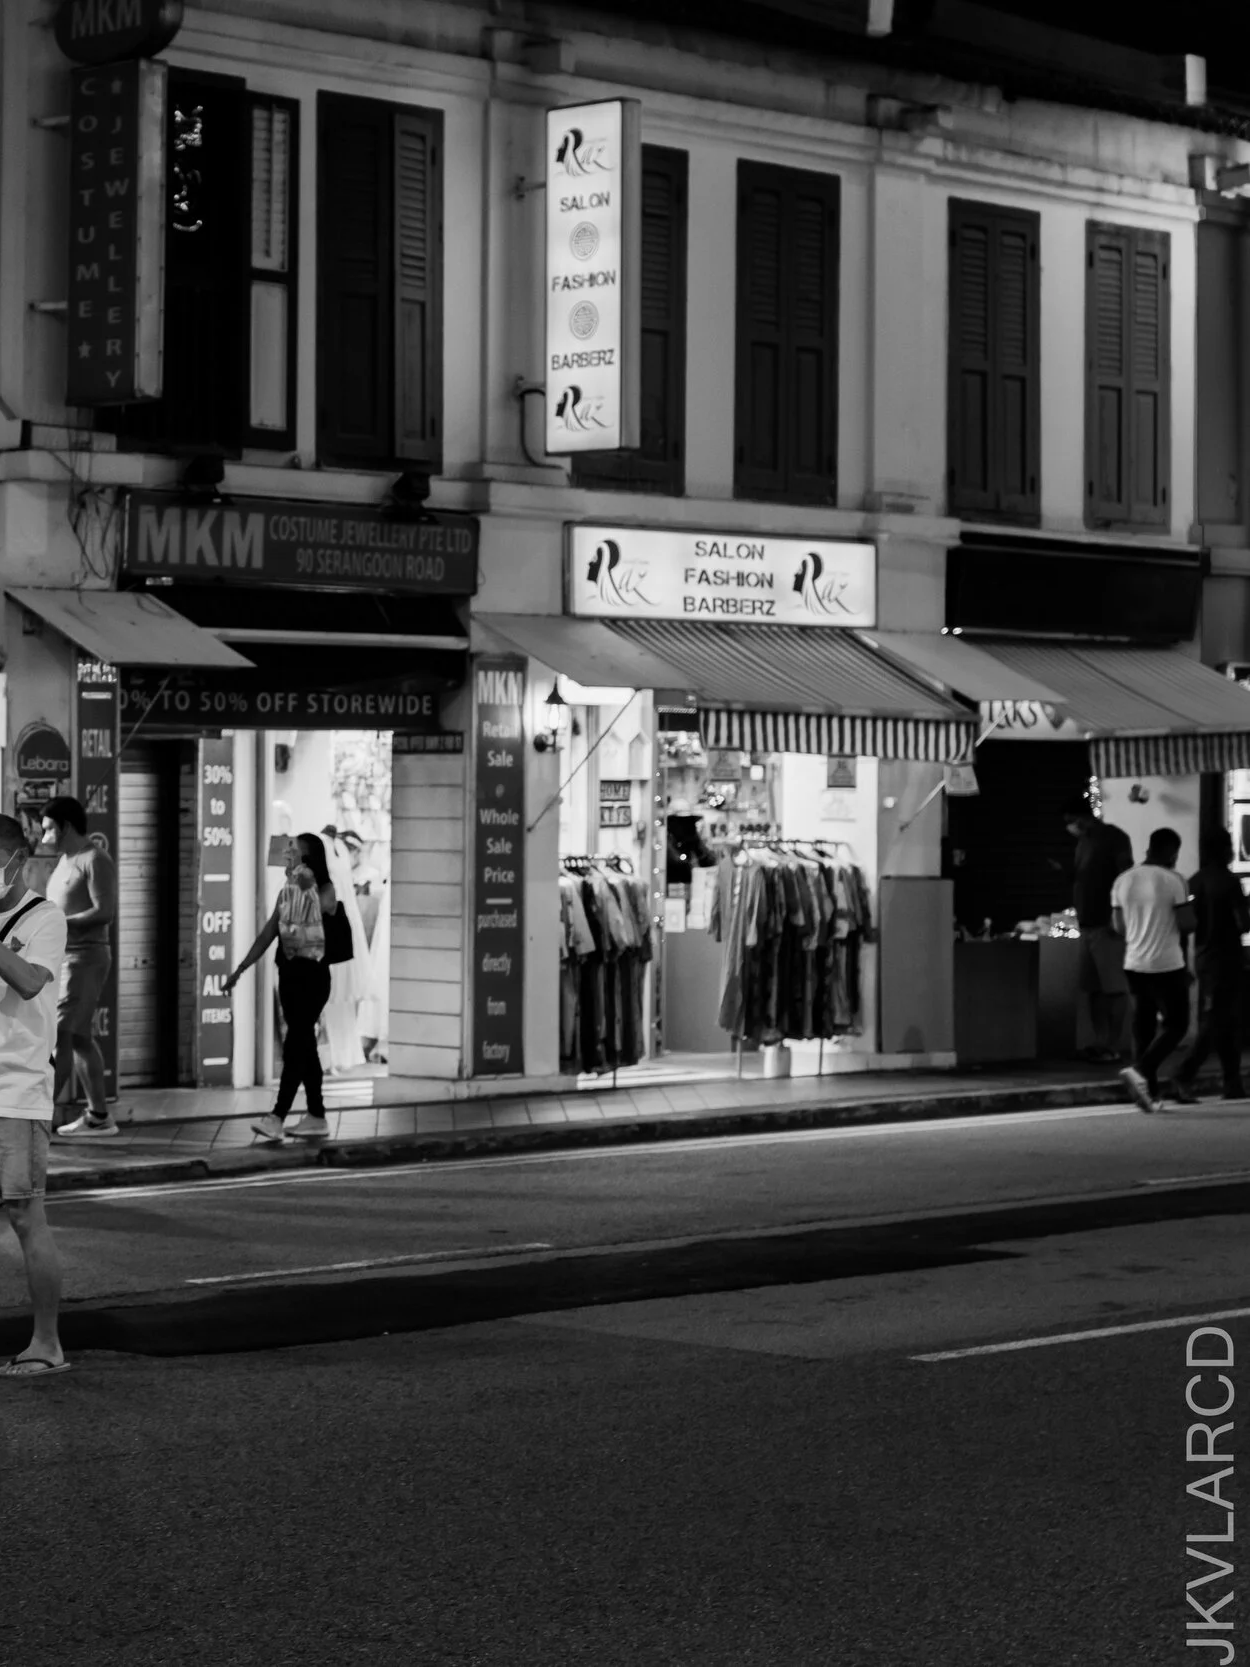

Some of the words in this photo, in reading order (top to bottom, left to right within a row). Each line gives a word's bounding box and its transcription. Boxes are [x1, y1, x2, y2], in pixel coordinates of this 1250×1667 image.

[71, 0, 143, 40] MKM
[77, 77, 100, 318] COSTUME
[560, 191, 611, 213] SALON
[103, 116, 130, 389] JEWELLERY
[552, 270, 617, 292] FASHION
[551, 348, 615, 371] BARBERZ
[138, 505, 265, 570] MKM
[270, 515, 338, 544] COSTUME
[339, 520, 414, 549] JEWELLERY
[418, 527, 444, 552] PTE
[446, 528, 473, 554] LTD
[695, 541, 765, 561] SALON
[296, 550, 313, 573] 90
[317, 550, 403, 579] SERANGOON
[405, 554, 446, 582] ROAD
[684, 568, 774, 589] FASHION
[684, 597, 776, 616] BARBERZ
[478, 670, 523, 705] MKM
[120, 689, 149, 712] 0%
[162, 689, 191, 711] TO
[200, 690, 248, 713] 50%
[257, 691, 298, 714] OFF
[306, 693, 433, 716] STOREWIDE
[483, 720, 519, 738] Retail
[81, 728, 112, 758] RETAIL
[20, 755, 69, 771] Lebara
[487, 750, 514, 768] Sale
[203, 765, 233, 784] 30%
[210, 797, 226, 815] to
[481, 809, 519, 827] Whole
[203, 827, 233, 846] 50%
[487, 838, 513, 855] Sale
[484, 867, 515, 885] Price
[203, 911, 232, 933] OFF
[482, 953, 512, 978] directly
[487, 996, 507, 1016] from
[483, 1041, 510, 1063] factory
